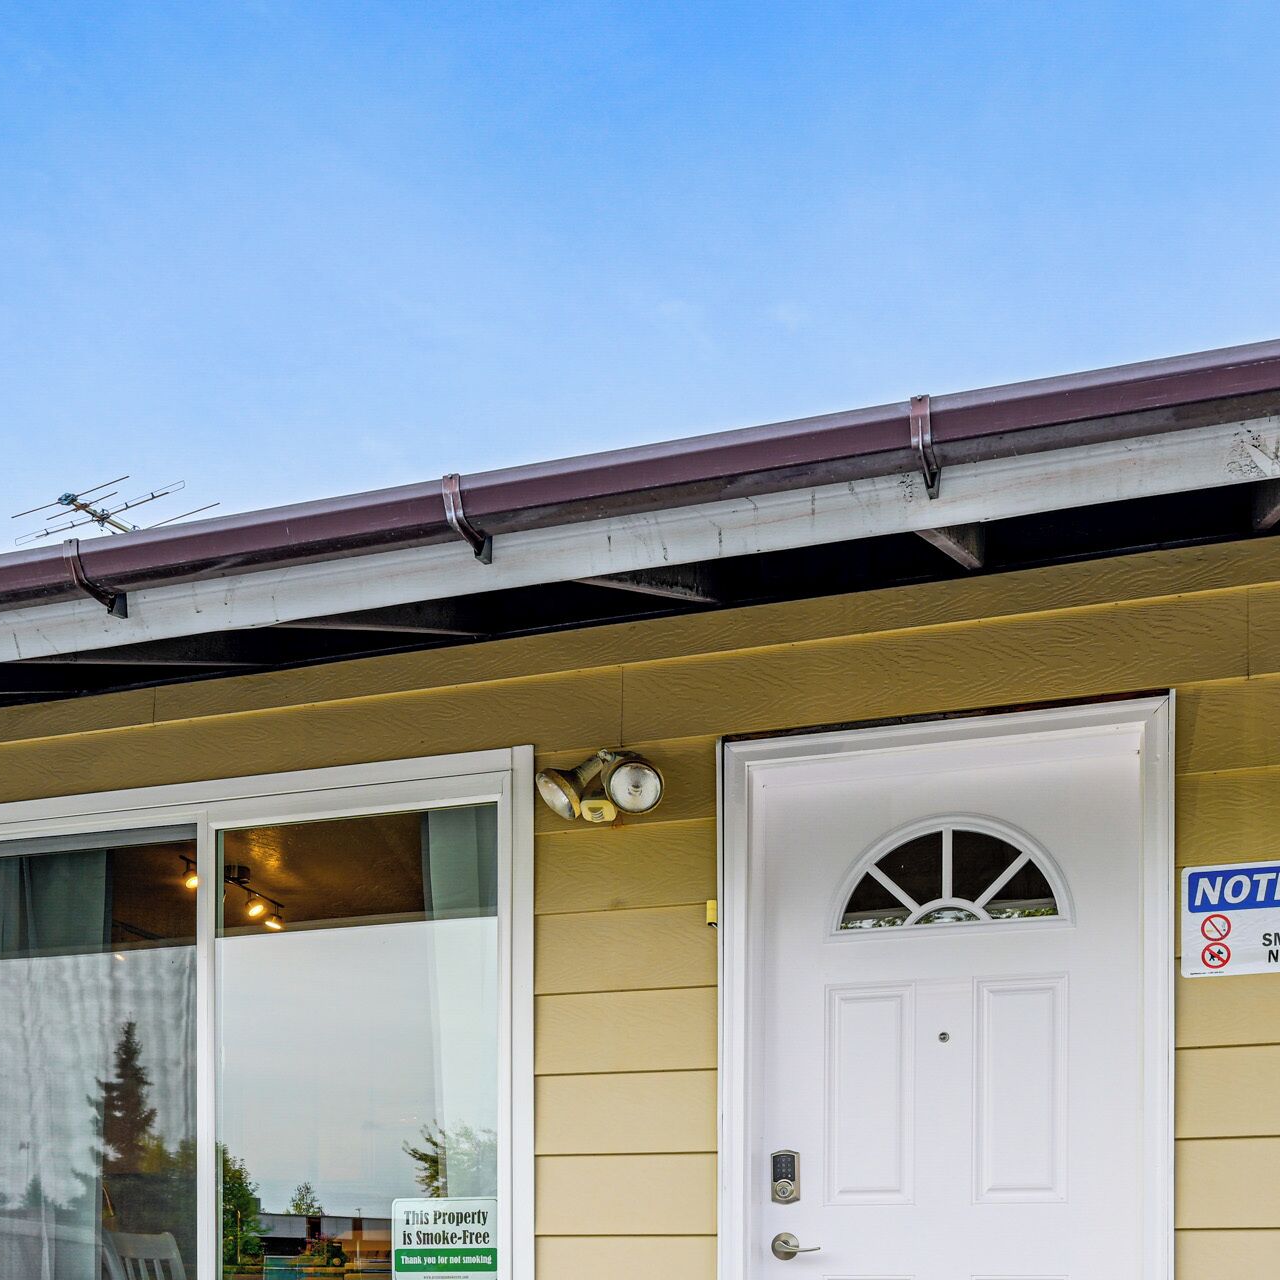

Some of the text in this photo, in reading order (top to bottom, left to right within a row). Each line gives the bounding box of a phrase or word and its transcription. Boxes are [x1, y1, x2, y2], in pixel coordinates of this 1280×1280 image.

[404, 1209, 488, 1226] This Property
[402, 1230, 490, 1245] is Smoke-Free
[401, 1254, 492, 1265] Thank you for not smoking
